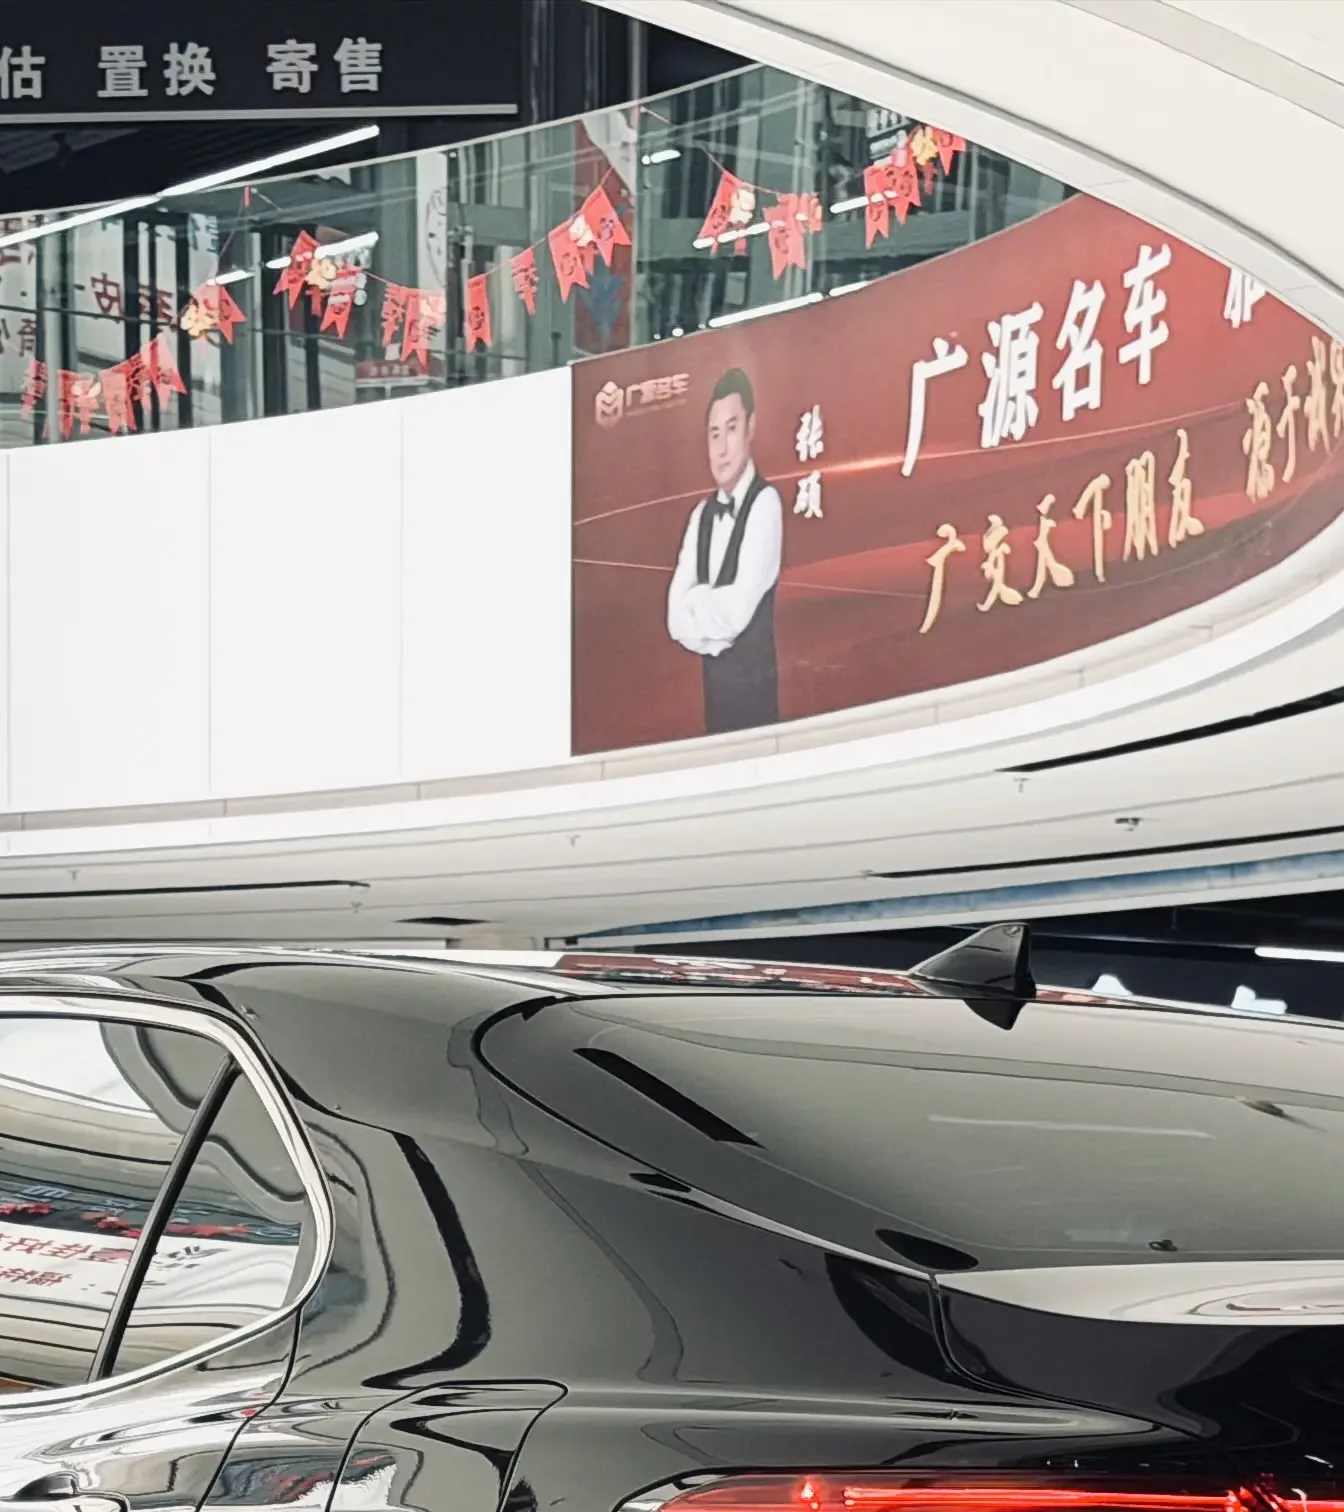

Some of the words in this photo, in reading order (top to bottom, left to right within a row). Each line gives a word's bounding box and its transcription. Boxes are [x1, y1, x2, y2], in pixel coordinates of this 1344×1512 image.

[97, 42, 217, 98] 置换
[265, 37, 385, 95] 寄售
[900, 243, 1172, 477] 广源名车
[918, 428, 1205, 634] 广交天下朋友
